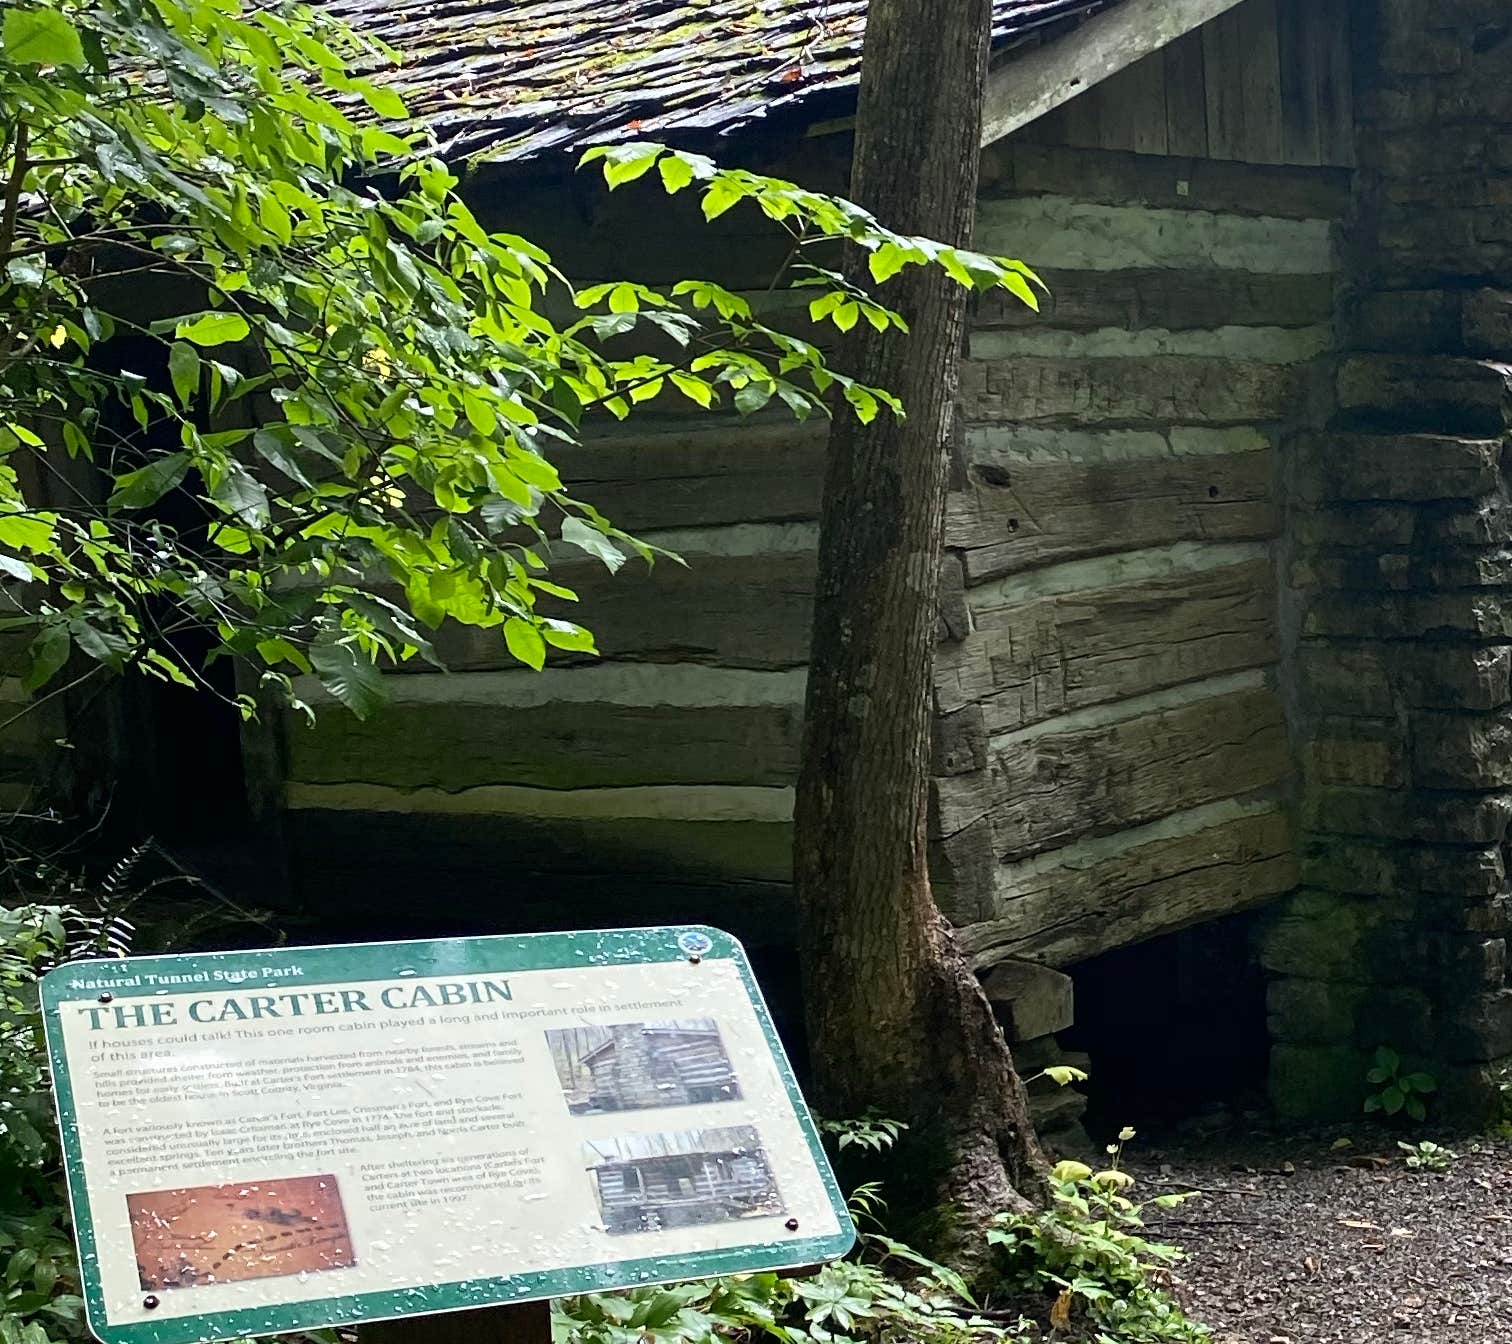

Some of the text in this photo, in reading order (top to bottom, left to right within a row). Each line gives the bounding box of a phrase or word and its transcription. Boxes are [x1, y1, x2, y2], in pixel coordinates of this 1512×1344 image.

[72, 965, 304, 990] Natural Tunnel State Park
[78, 980, 512, 1030] THE CARTER CABIN
[88, 1040, 99, 1050] If
[102, 1036, 152, 1049] houses
[156, 1033, 196, 1045] could
[235, 1028, 264, 1039] This
[267, 1028, 293, 1037] one
[297, 1025, 334, 1034] room
[338, 1020, 376, 1031] cabin
[380, 1016, 424, 1031] played
[428, 1017, 436, 1025] a
[439, 1013, 470, 1027] long
[474, 1011, 498, 1022] and
[501, 1006, 568, 1022] important
[571, 1004, 595, 1014] role
[599, 1003, 610, 1012] in
[614, 997, 682, 1011] settlement
[90, 1049, 174, 1063] of this area.
[244, 1059, 255, 1067] of
